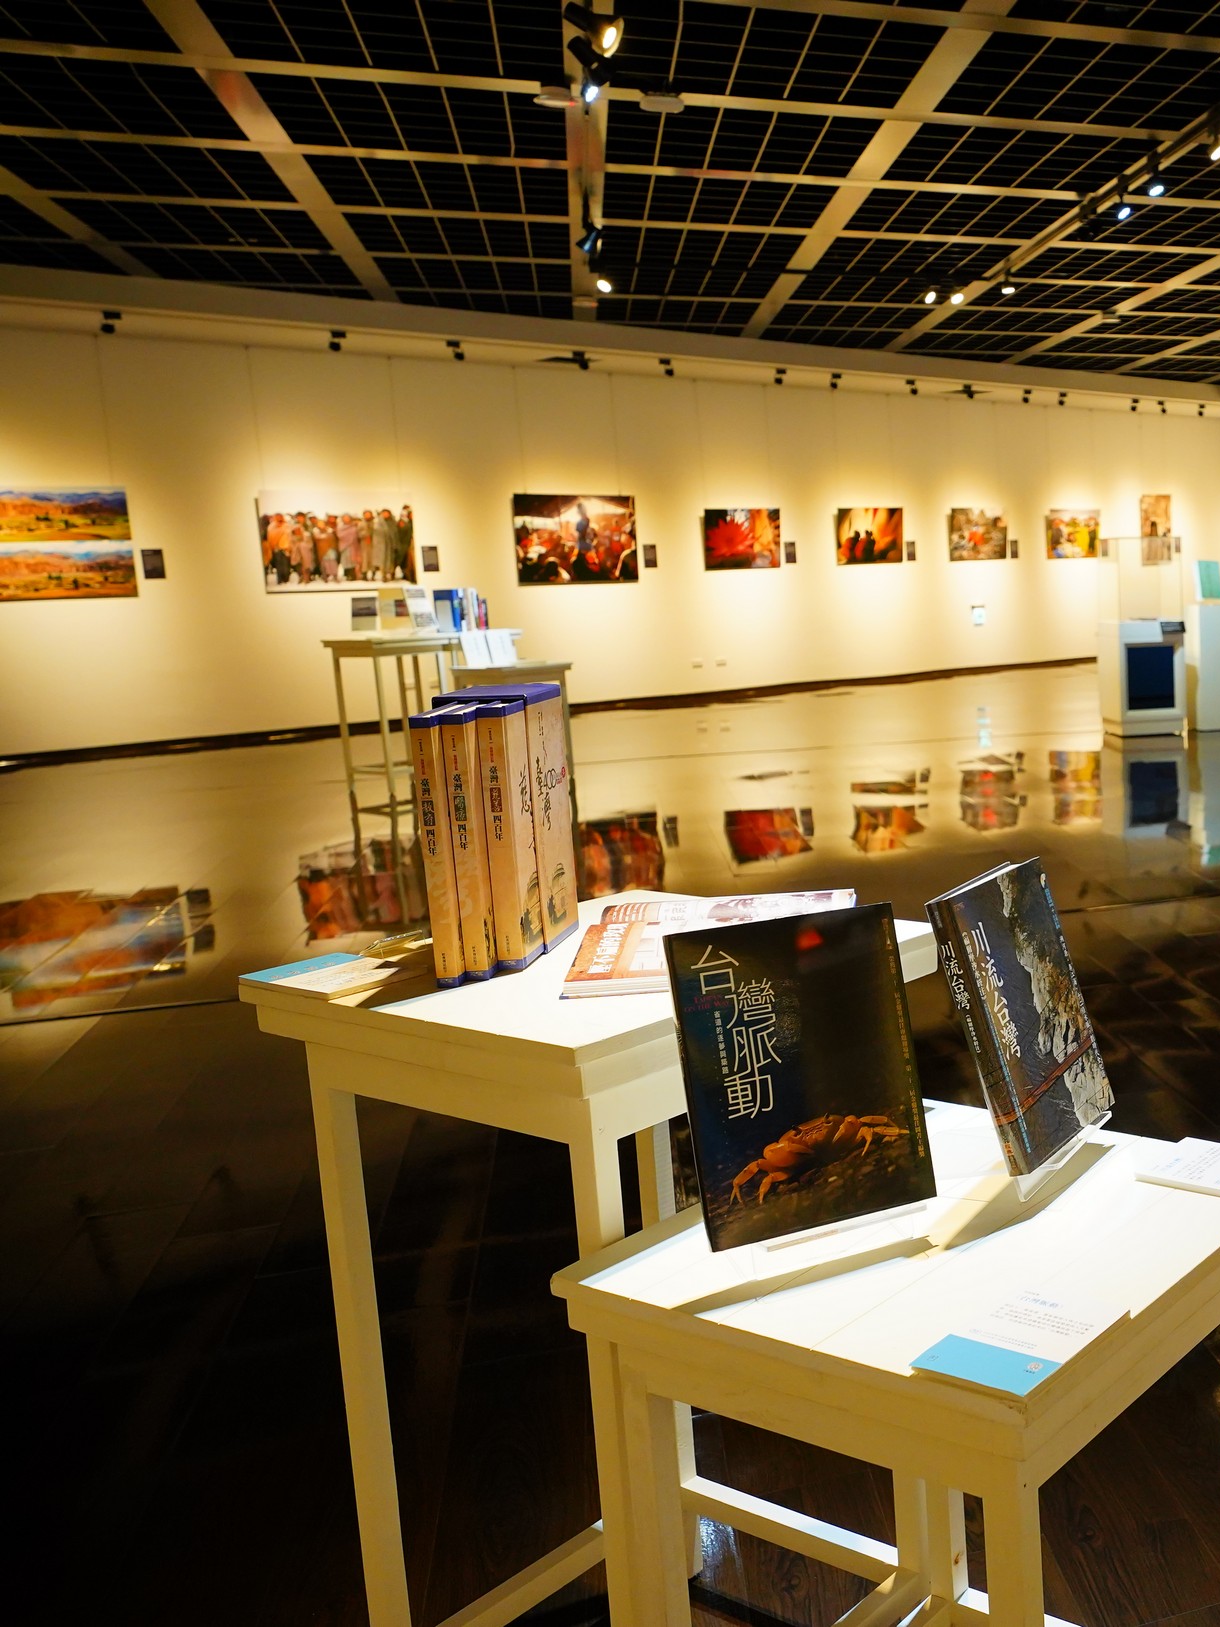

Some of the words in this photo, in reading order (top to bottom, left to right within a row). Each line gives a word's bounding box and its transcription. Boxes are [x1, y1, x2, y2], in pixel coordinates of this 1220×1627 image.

[690, 944, 782, 1120] 台灣脈動
[941, 940, 970, 1010] 川流台灣
[971, 921, 1022, 1060] 川流台灣
